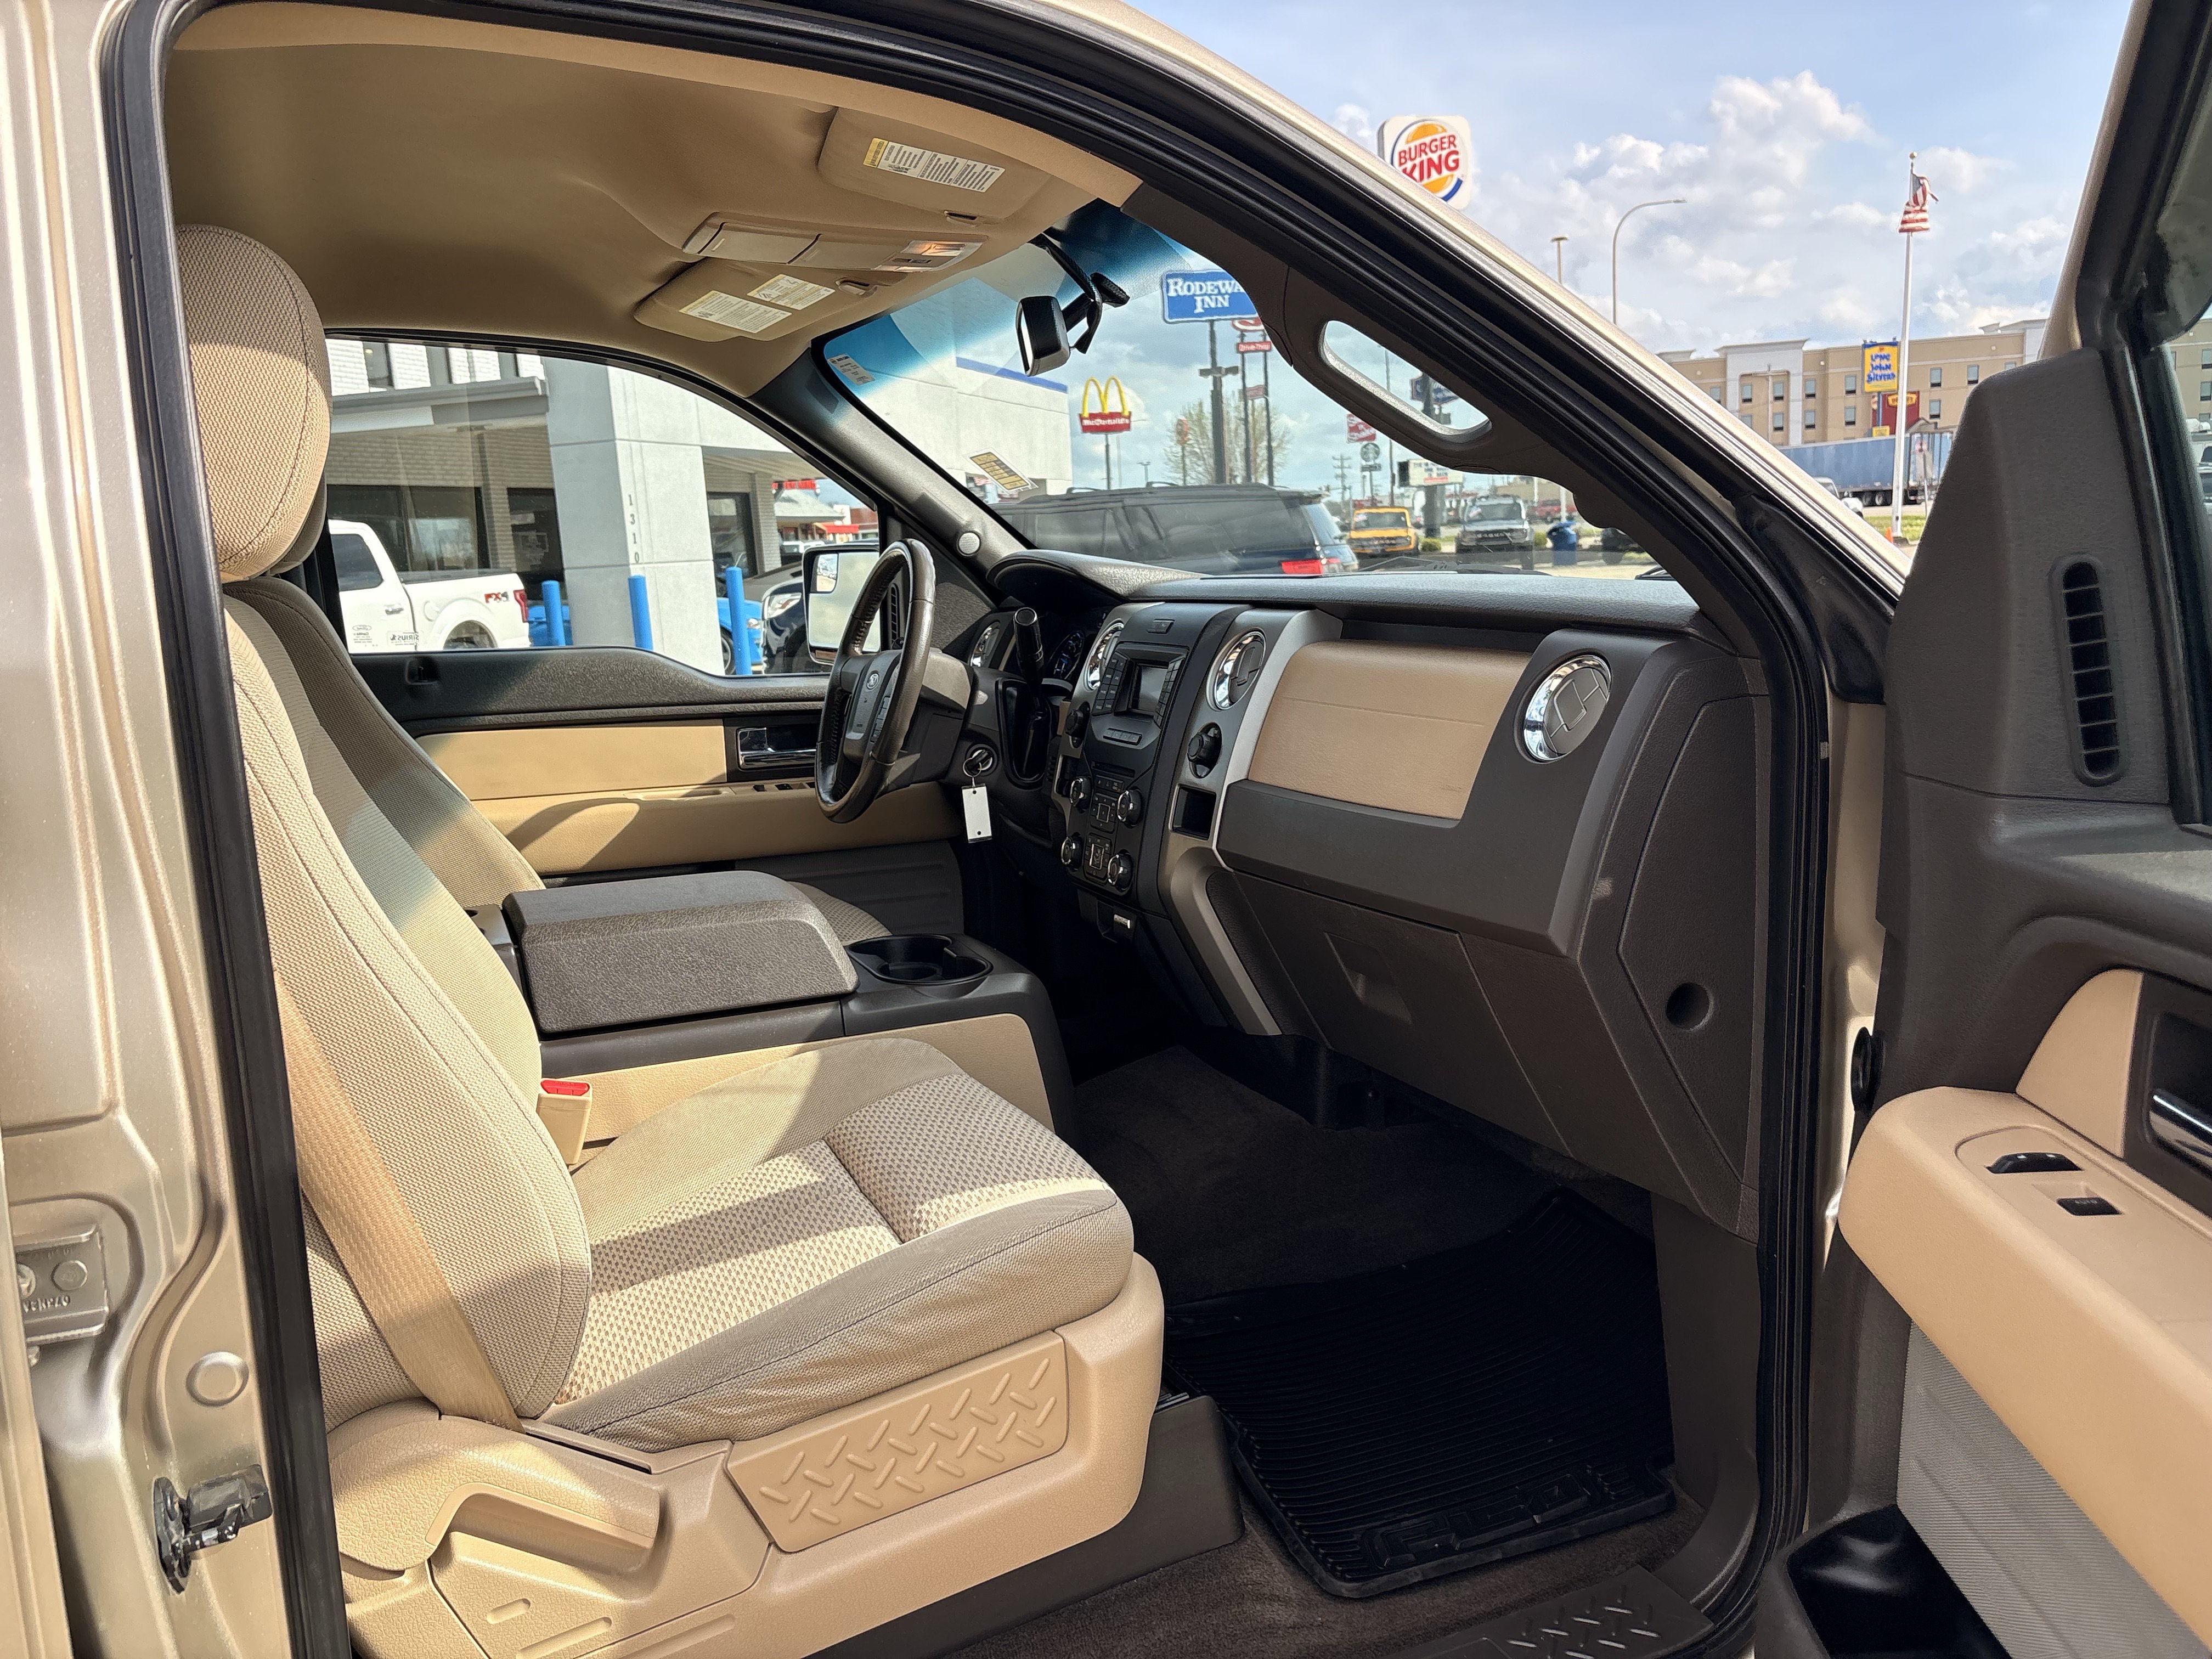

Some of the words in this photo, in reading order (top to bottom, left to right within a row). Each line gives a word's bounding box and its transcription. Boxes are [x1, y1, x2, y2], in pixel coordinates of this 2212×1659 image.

[1397, 134, 1457, 167] BURGER
[1401, 150, 1459, 182] KING
[1167, 278, 1245, 297] RODEWA
[1193, 295, 1230, 313] INN
[484, 591, 509, 603] FX4
